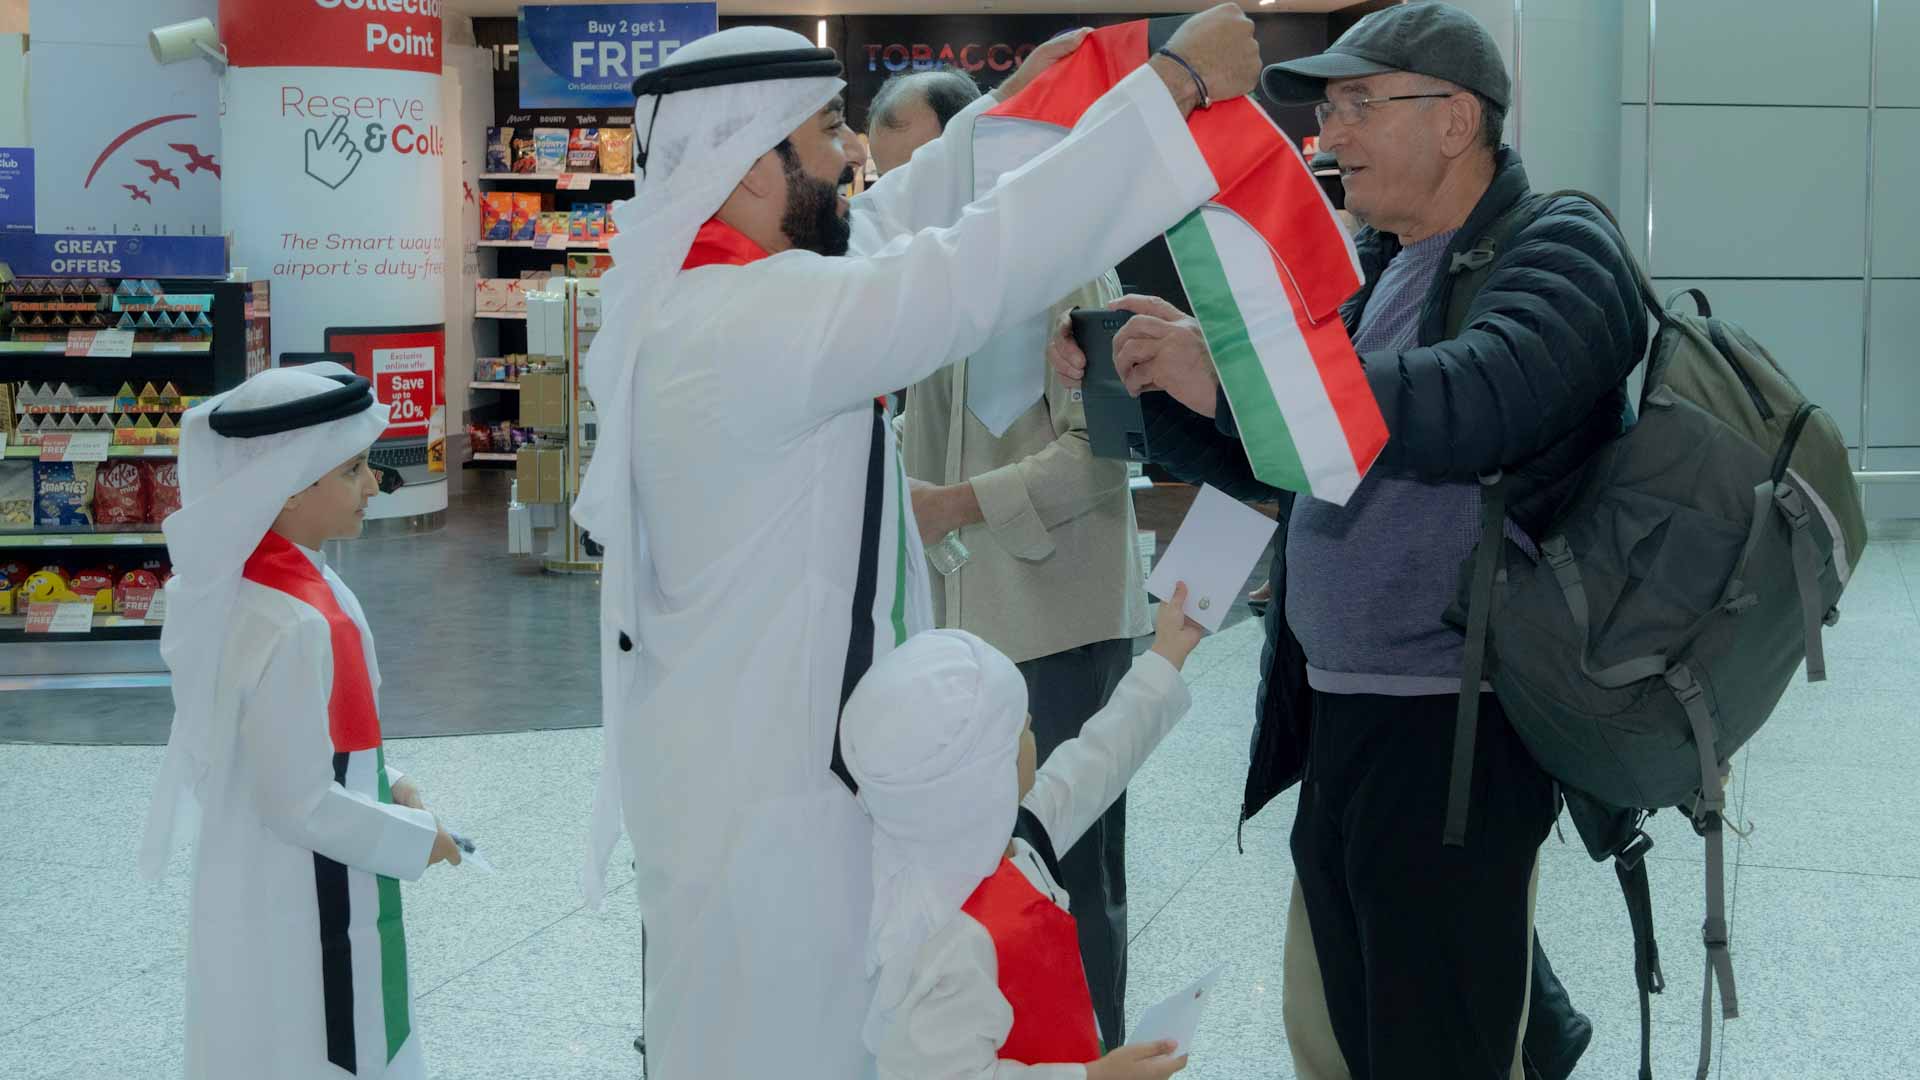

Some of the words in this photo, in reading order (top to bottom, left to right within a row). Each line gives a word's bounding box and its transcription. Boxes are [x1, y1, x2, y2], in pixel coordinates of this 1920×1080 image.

[588, 20, 616, 36] Buy
[619, 20, 628, 33] 2
[631, 20, 655, 36] get
[658, 20, 666, 32] 1
[367, 23, 434, 56] Point
[282, 86, 424, 121] Reserve
[540, 115, 567, 123] BOUNTY
[364, 123, 388, 153] &
[54, 239, 117, 254] GREAT
[281, 233, 319, 250] The
[326, 233, 394, 250] Smart
[399, 236, 432, 254] way
[51, 258, 122, 273] OFFERS
[273, 258, 369, 280] airport's
[391, 375, 425, 391] Save
[403, 391, 411, 399] to
[391, 399, 424, 419] 20%
[102, 463, 138, 488] KitKat
